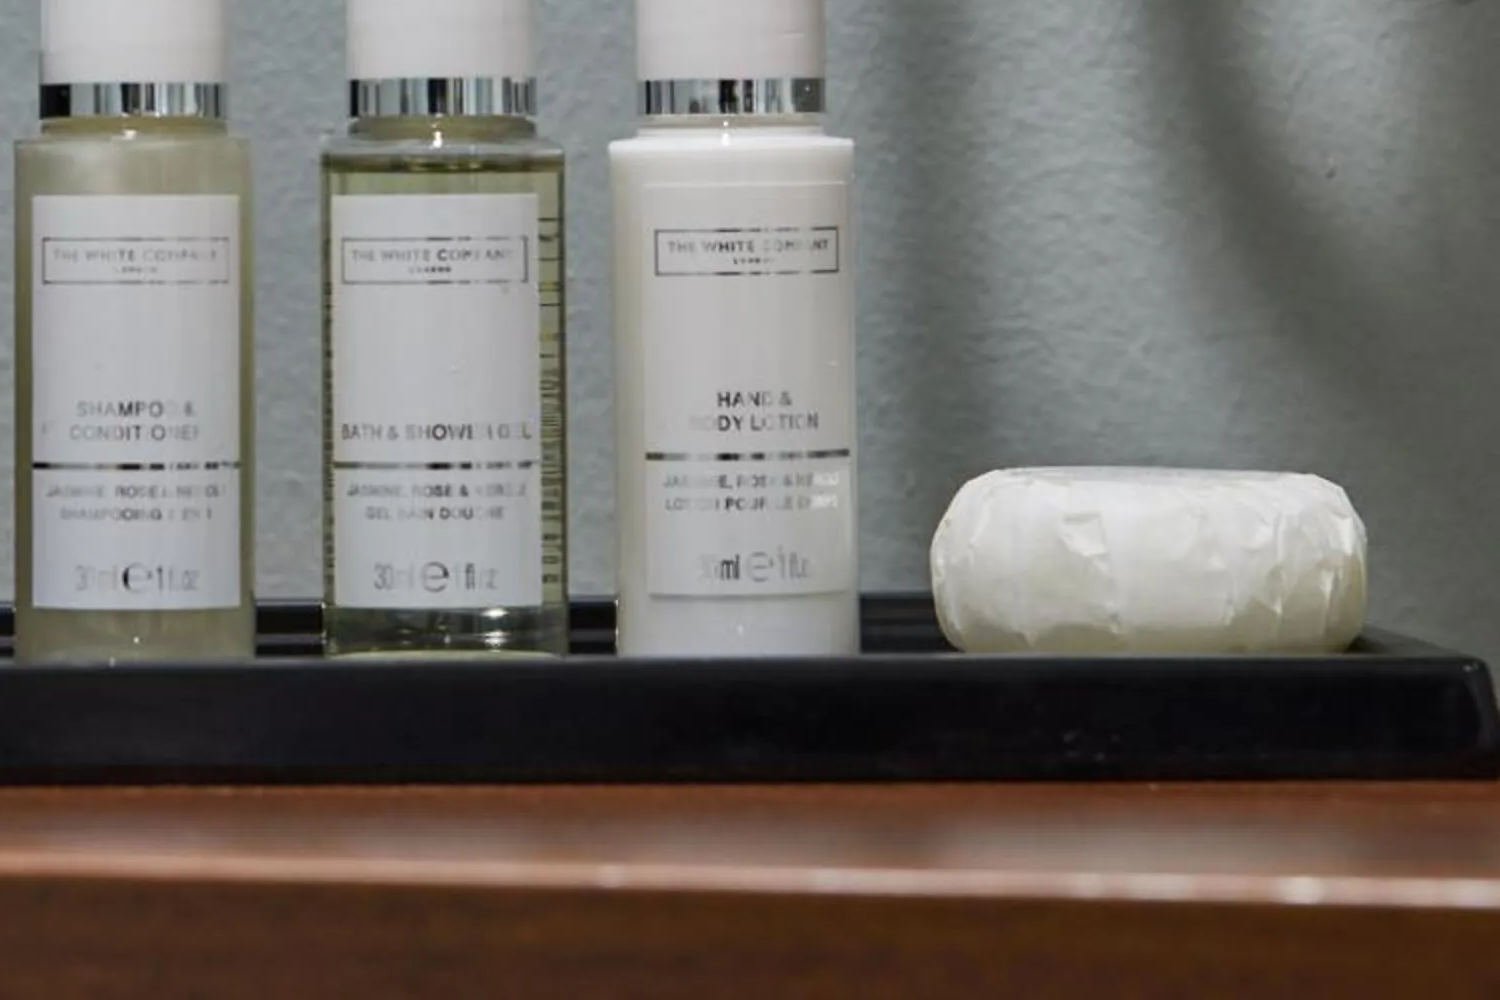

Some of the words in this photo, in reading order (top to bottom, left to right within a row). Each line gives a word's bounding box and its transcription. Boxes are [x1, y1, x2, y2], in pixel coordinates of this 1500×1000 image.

[666, 239, 696, 253] THE
[701, 239, 755, 254] WHITE
[351, 247, 375, 262] THE
[778, 390, 793, 406] &
[386, 423, 399, 441] &
